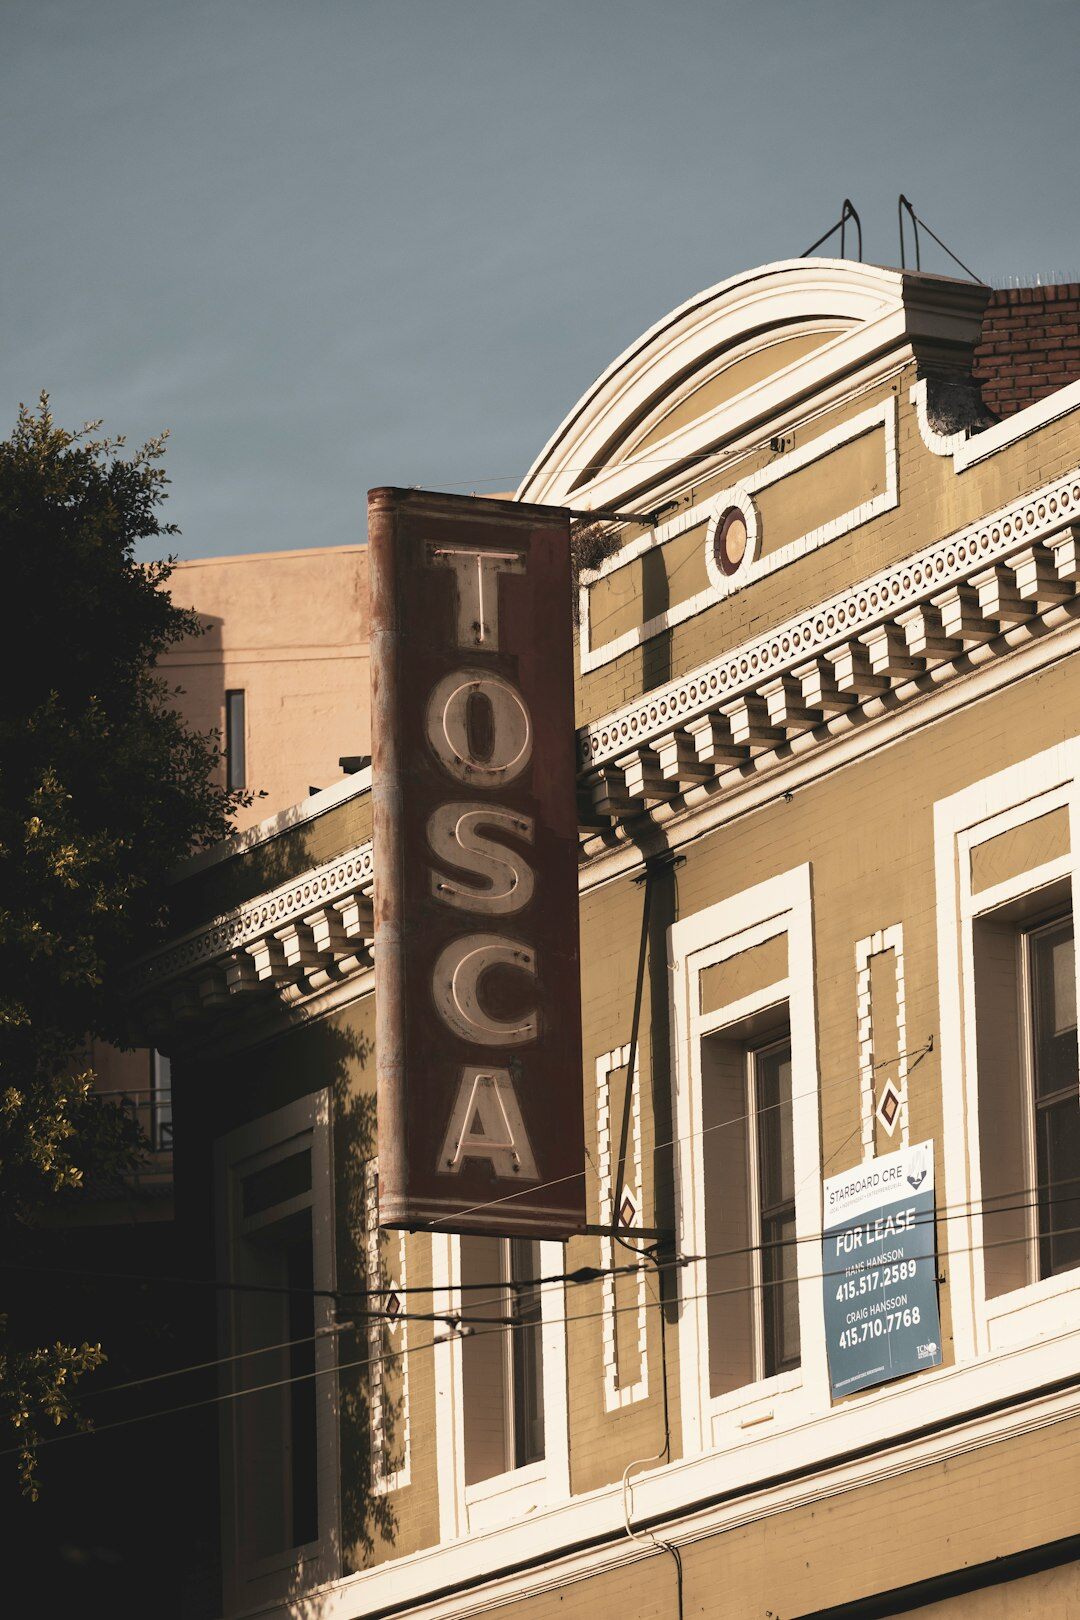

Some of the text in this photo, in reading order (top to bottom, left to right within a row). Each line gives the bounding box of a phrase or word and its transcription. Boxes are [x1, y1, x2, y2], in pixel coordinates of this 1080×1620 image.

[424, 540, 541, 1180] TOSCA
[829, 1165, 903, 1205] STARBOARD CRE
[836, 1208, 916, 1256] FOR LEASE
[835, 1259, 917, 1302] 415.517.2589
[845, 1247, 904, 1278] HANS HANSSON
[839, 1306, 921, 1349] 415.710.7768
[846, 1294, 908, 1324] CRAIG HANSSON
